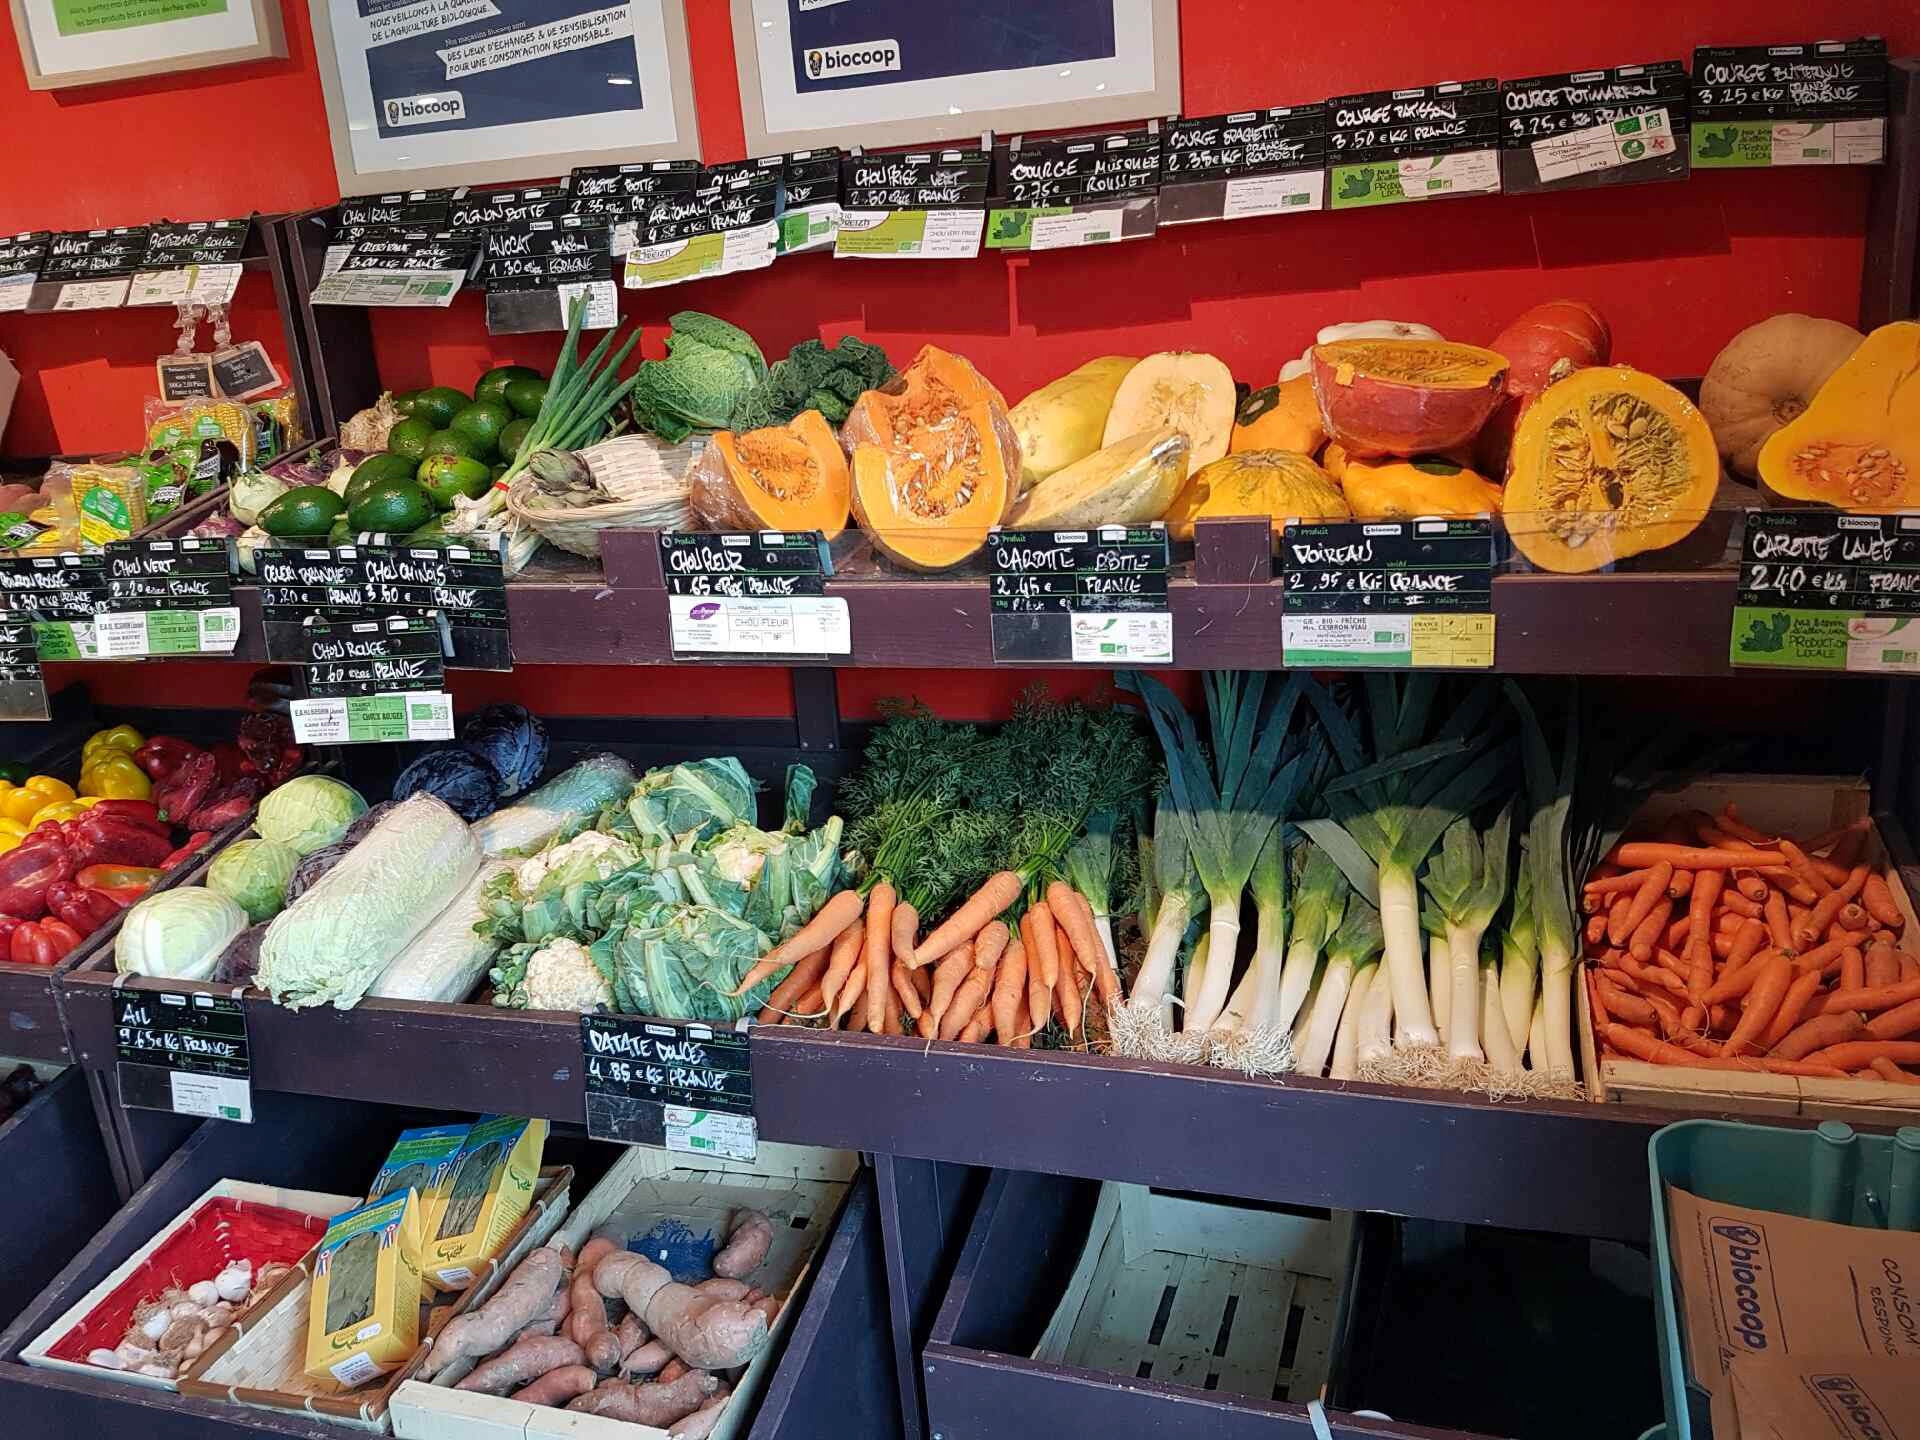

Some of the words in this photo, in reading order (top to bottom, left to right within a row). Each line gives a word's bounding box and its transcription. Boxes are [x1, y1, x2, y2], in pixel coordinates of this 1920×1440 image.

[447, 50, 462, 62] DES
[559, 10, 627, 35] SENSIBILISATION
[471, 57, 488, 68] UNE
[825, 49, 895, 69] biocoop
[1704, 63, 1771, 85] COURGE
[401, 99, 460, 117] biocoop
[1505, 89, 1560, 111] COURGE
[1336, 104, 1392, 128] COURGE
[1168, 129, 1220, 150] COURGE
[1414, 120, 1467, 141] FRANCE
[856, 166, 887, 187] CHOU
[930, 170, 968, 187] VERT
[1010, 158, 1079, 181] COURGE
[1087, 173, 1151, 192] ROUSSET
[918, 184, 970, 203] FRANCE
[506, 202, 550, 222] BOTTE
[53, 239, 96, 255] NAVET
[489, 233, 534, 257] AVOCAT
[1847, 520, 1880, 528] biocoop
[1292, 539, 1373, 565] POIREAU
[1753, 531, 1841, 559] CAROTTE
[112, 558, 141, 577] CHOU
[143, 558, 176, 575] VERT
[365, 557, 399, 582] CHOU
[670, 547, 703, 574] CHOU
[996, 547, 1075, 571] CAROTTE
[169, 581, 210, 596] FRANCE
[748, 576, 800, 596] FRANCE
[1085, 574, 1142, 594] FRANCE
[1389, 573, 1464, 592] FRANCE
[1811, 575, 1823, 588] €
[433, 587, 478, 608] FRANCE
[312, 640, 345, 660] CHOU
[345, 640, 388, 657] ROUGE
[374, 658, 427, 681] FRANCE
[122, 1000, 151, 1025] AIL
[182, 1035, 240, 1057] FRANCE
[589, 1030, 653, 1057] PATATE
[656, 1040, 704, 1064] DOUCE
[646, 1066, 665, 1084] KG
[669, 1070, 729, 1091] FRANCE
[1728, 1244, 1768, 1350] biocoop
